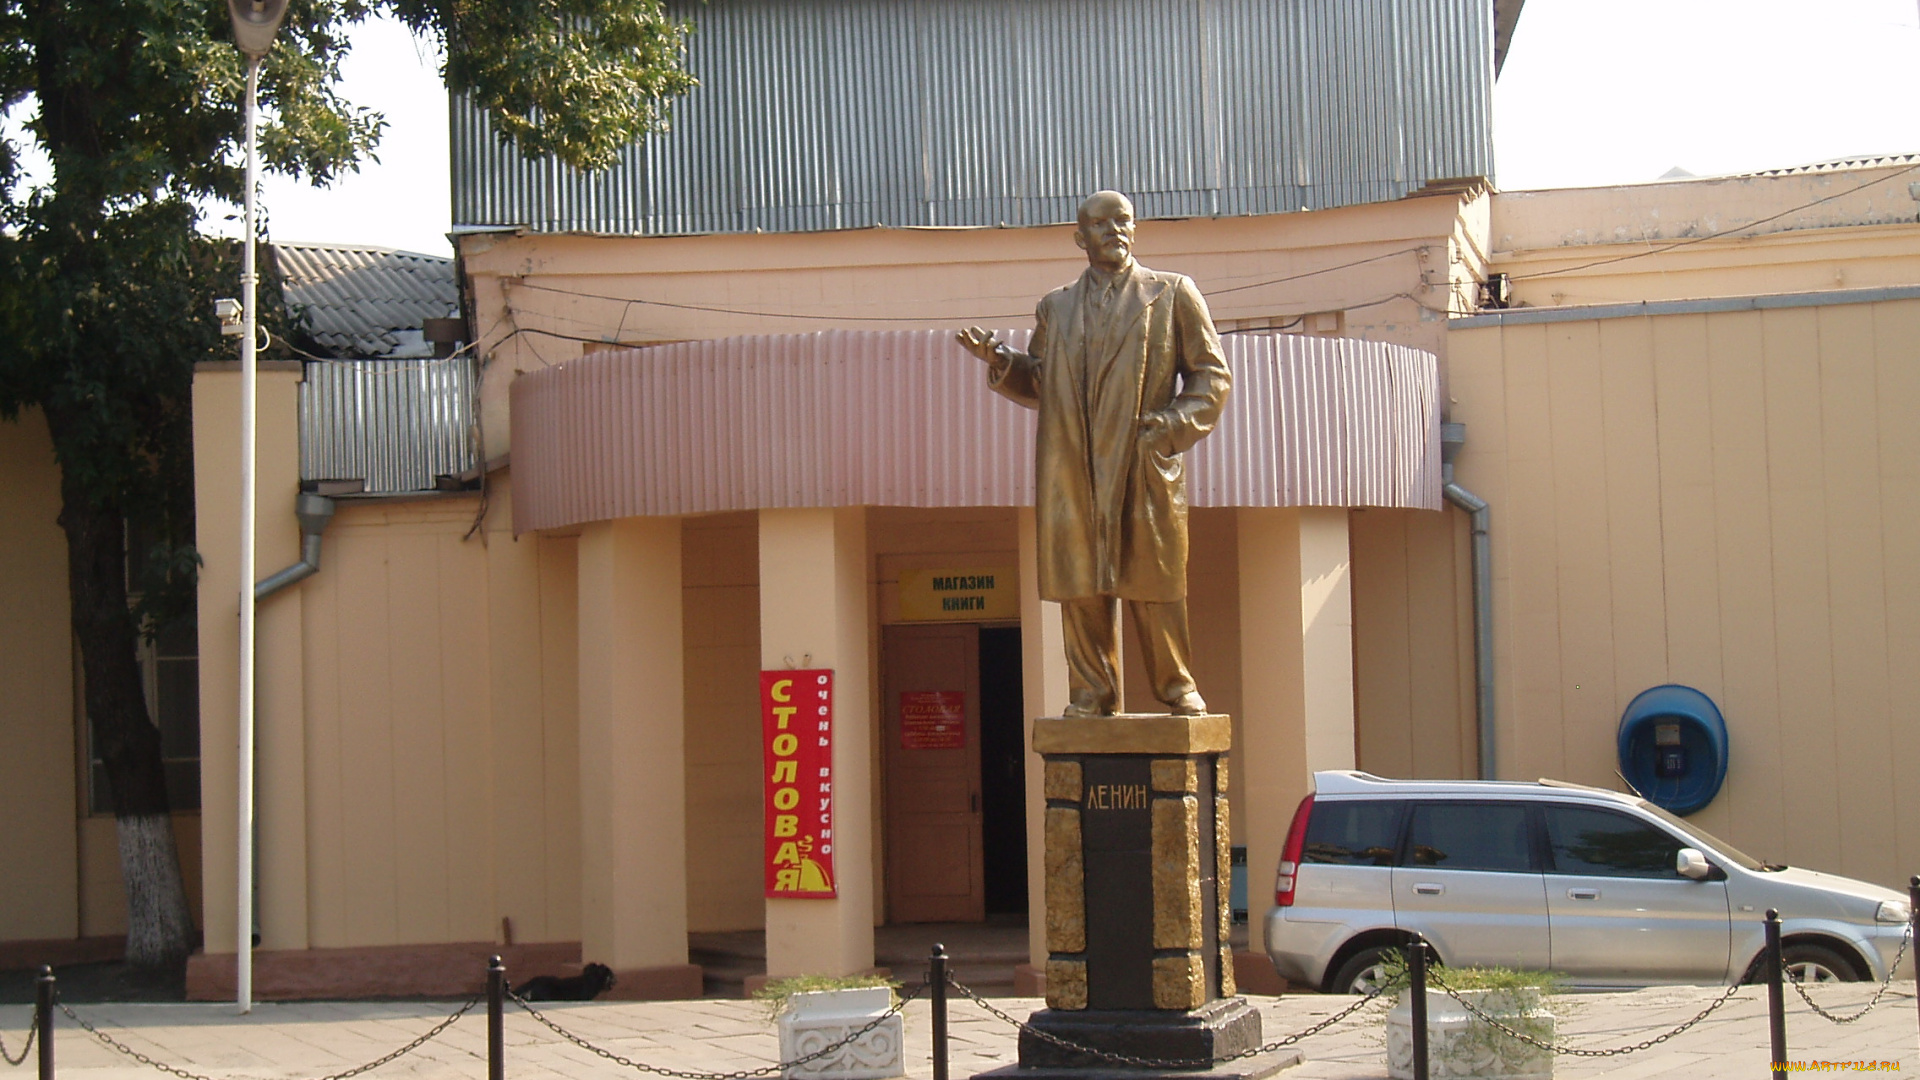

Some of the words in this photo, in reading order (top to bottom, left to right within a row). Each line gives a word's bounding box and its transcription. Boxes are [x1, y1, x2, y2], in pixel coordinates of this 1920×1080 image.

[932, 575, 995, 591] МАГАЗИН
[942, 596, 985, 611] КНИГИ
[817, 675, 829, 747] очень
[771, 679, 800, 891] СТОЛОВАЯ
[1087, 784, 1147, 810] ЛЕНИН
[819, 767, 832, 855] вкусно
